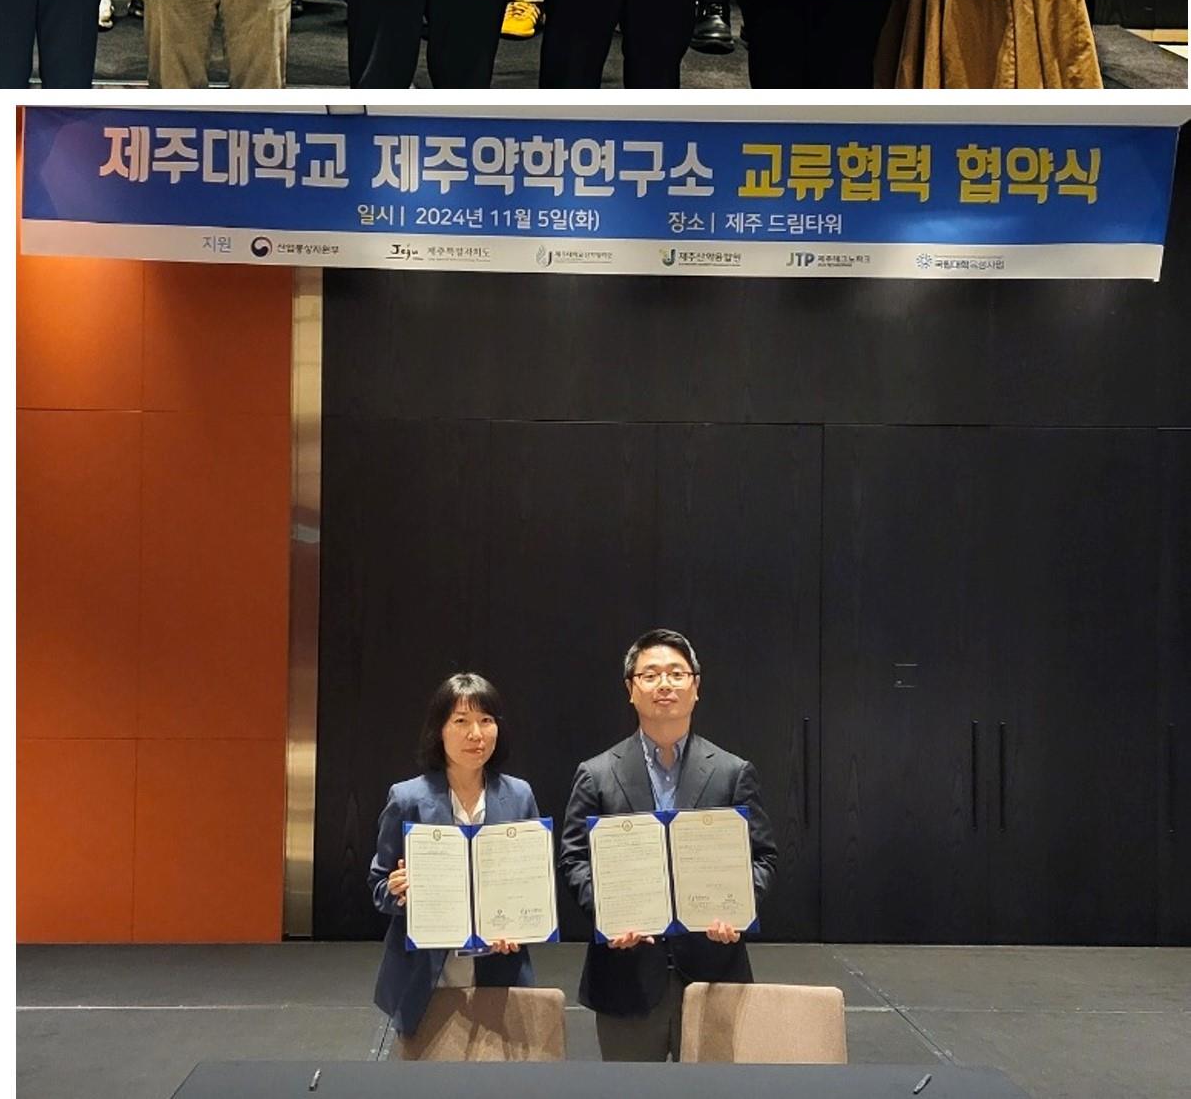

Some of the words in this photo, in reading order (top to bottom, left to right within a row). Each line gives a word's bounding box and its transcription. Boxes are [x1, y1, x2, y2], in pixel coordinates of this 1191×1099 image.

[99, 125, 349, 189] 제주대학교
[371, 134, 714, 198] 제주약학연구소
[738, 141, 931, 203] 교류협력
[956, 143, 1101, 204] 협약식
[416, 206, 483, 228] 2024년
[491, 208, 531, 229] 11월
[538, 209, 600, 231] 5일(화)
[725, 213, 762, 234] 제주
[767, 213, 843, 235] 드림타워
[202, 236, 231, 253] 지원
[786, 252, 815, 267] JTP
